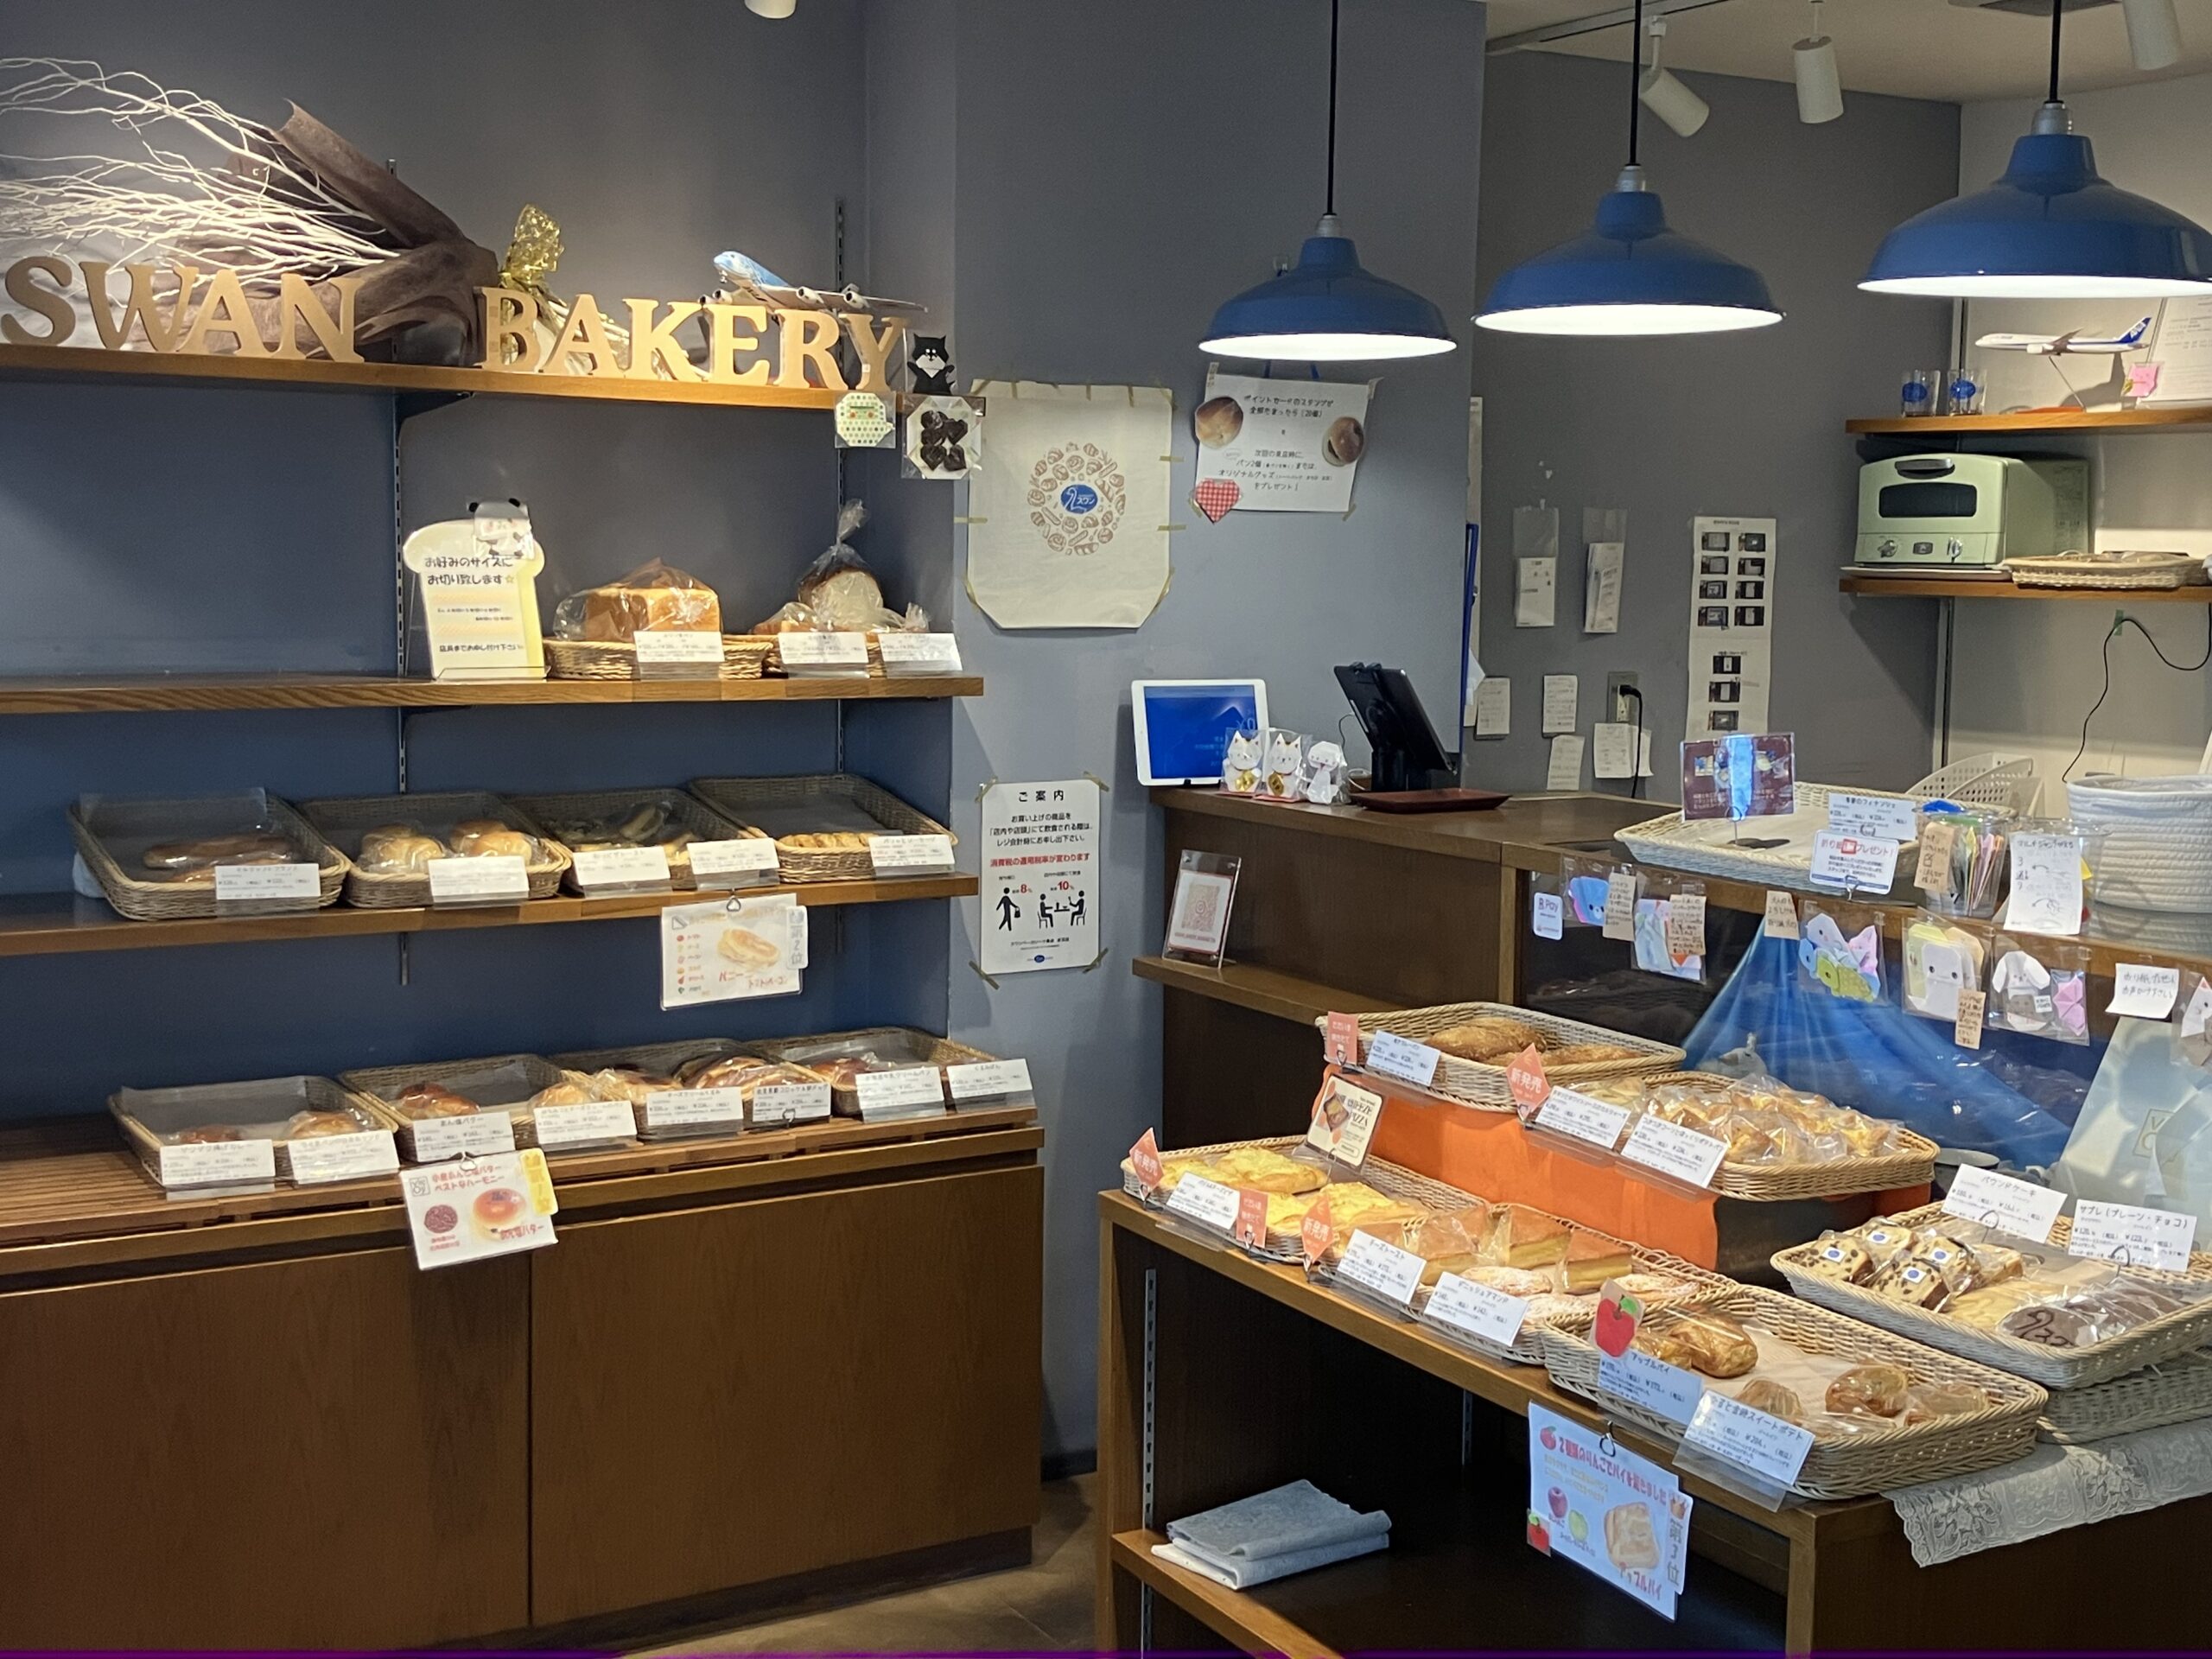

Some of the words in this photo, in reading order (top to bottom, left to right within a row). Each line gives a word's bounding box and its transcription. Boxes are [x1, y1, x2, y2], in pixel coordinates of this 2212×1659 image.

[1, 256, 365, 363] SWAN
[474, 286, 909, 391] BAKERY
[424, 556, 513, 568] お好みのサイズに
[1011, 812, 1071, 823] お買い上げの商品を
[1512, 1066, 1541, 1094] 新発売
[1133, 1150, 1159, 1176] 新発売
[1981, 1176, 2037, 1198] パウンドケーキ
[1303, 1217, 1330, 1243] 新発売
[1630, 1351, 1670, 1376] アップルパイ
